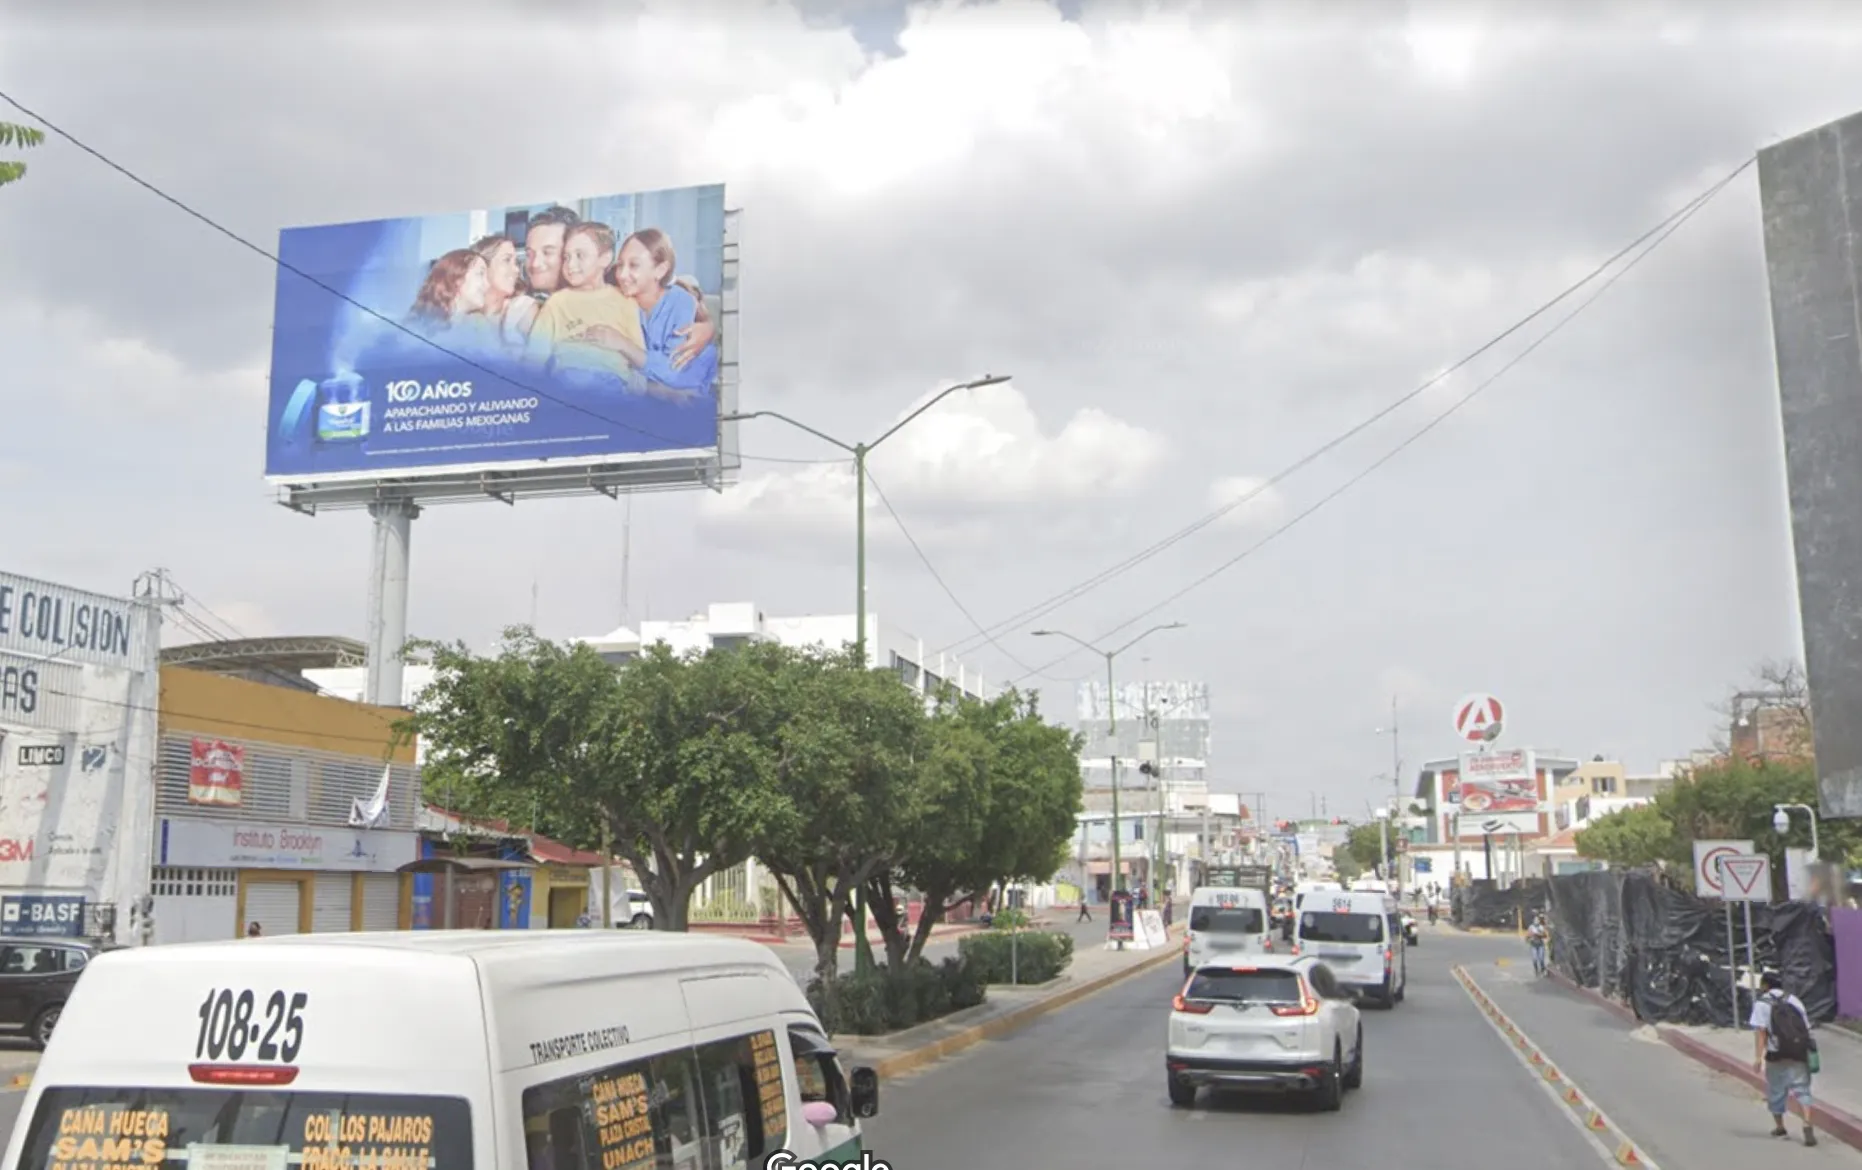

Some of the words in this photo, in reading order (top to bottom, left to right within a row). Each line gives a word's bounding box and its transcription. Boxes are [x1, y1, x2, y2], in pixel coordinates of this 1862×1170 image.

[385, 380, 421, 403] 100
[421, 380, 473, 400] AÑOS
[384, 402, 468, 418] APAPACHANDO
[468, 402, 477, 412] Y
[477, 397, 539, 412] ALIVIANDO
[383, 422, 392, 432] A
[394, 420, 414, 432] LAS
[415, 416, 464, 430] FAMILIAS
[465, 412, 531, 427] MEXICANAS
[20, 592, 131, 656] COLISION
[0, 838, 34, 862] 3M
[233, 827, 275, 849] Instituto
[280, 828, 323, 855] Brooklyn
[31, 903, 80, 922] BASF
[196, 987, 308, 1063] 108-25
[529, 1033, 585, 1065] TRANSPORTE
[586, 1025, 630, 1051] COLECTIVO
[109, 1110, 168, 1137] HUECA
[596, 1094, 648, 1126] SAM'S
[340, 1115, 366, 1142] LOS
[368, 1115, 433, 1144] PAJAROS
[56, 1136, 165, 1164] SAM'S
[602, 1136, 656, 1170] UNACH
